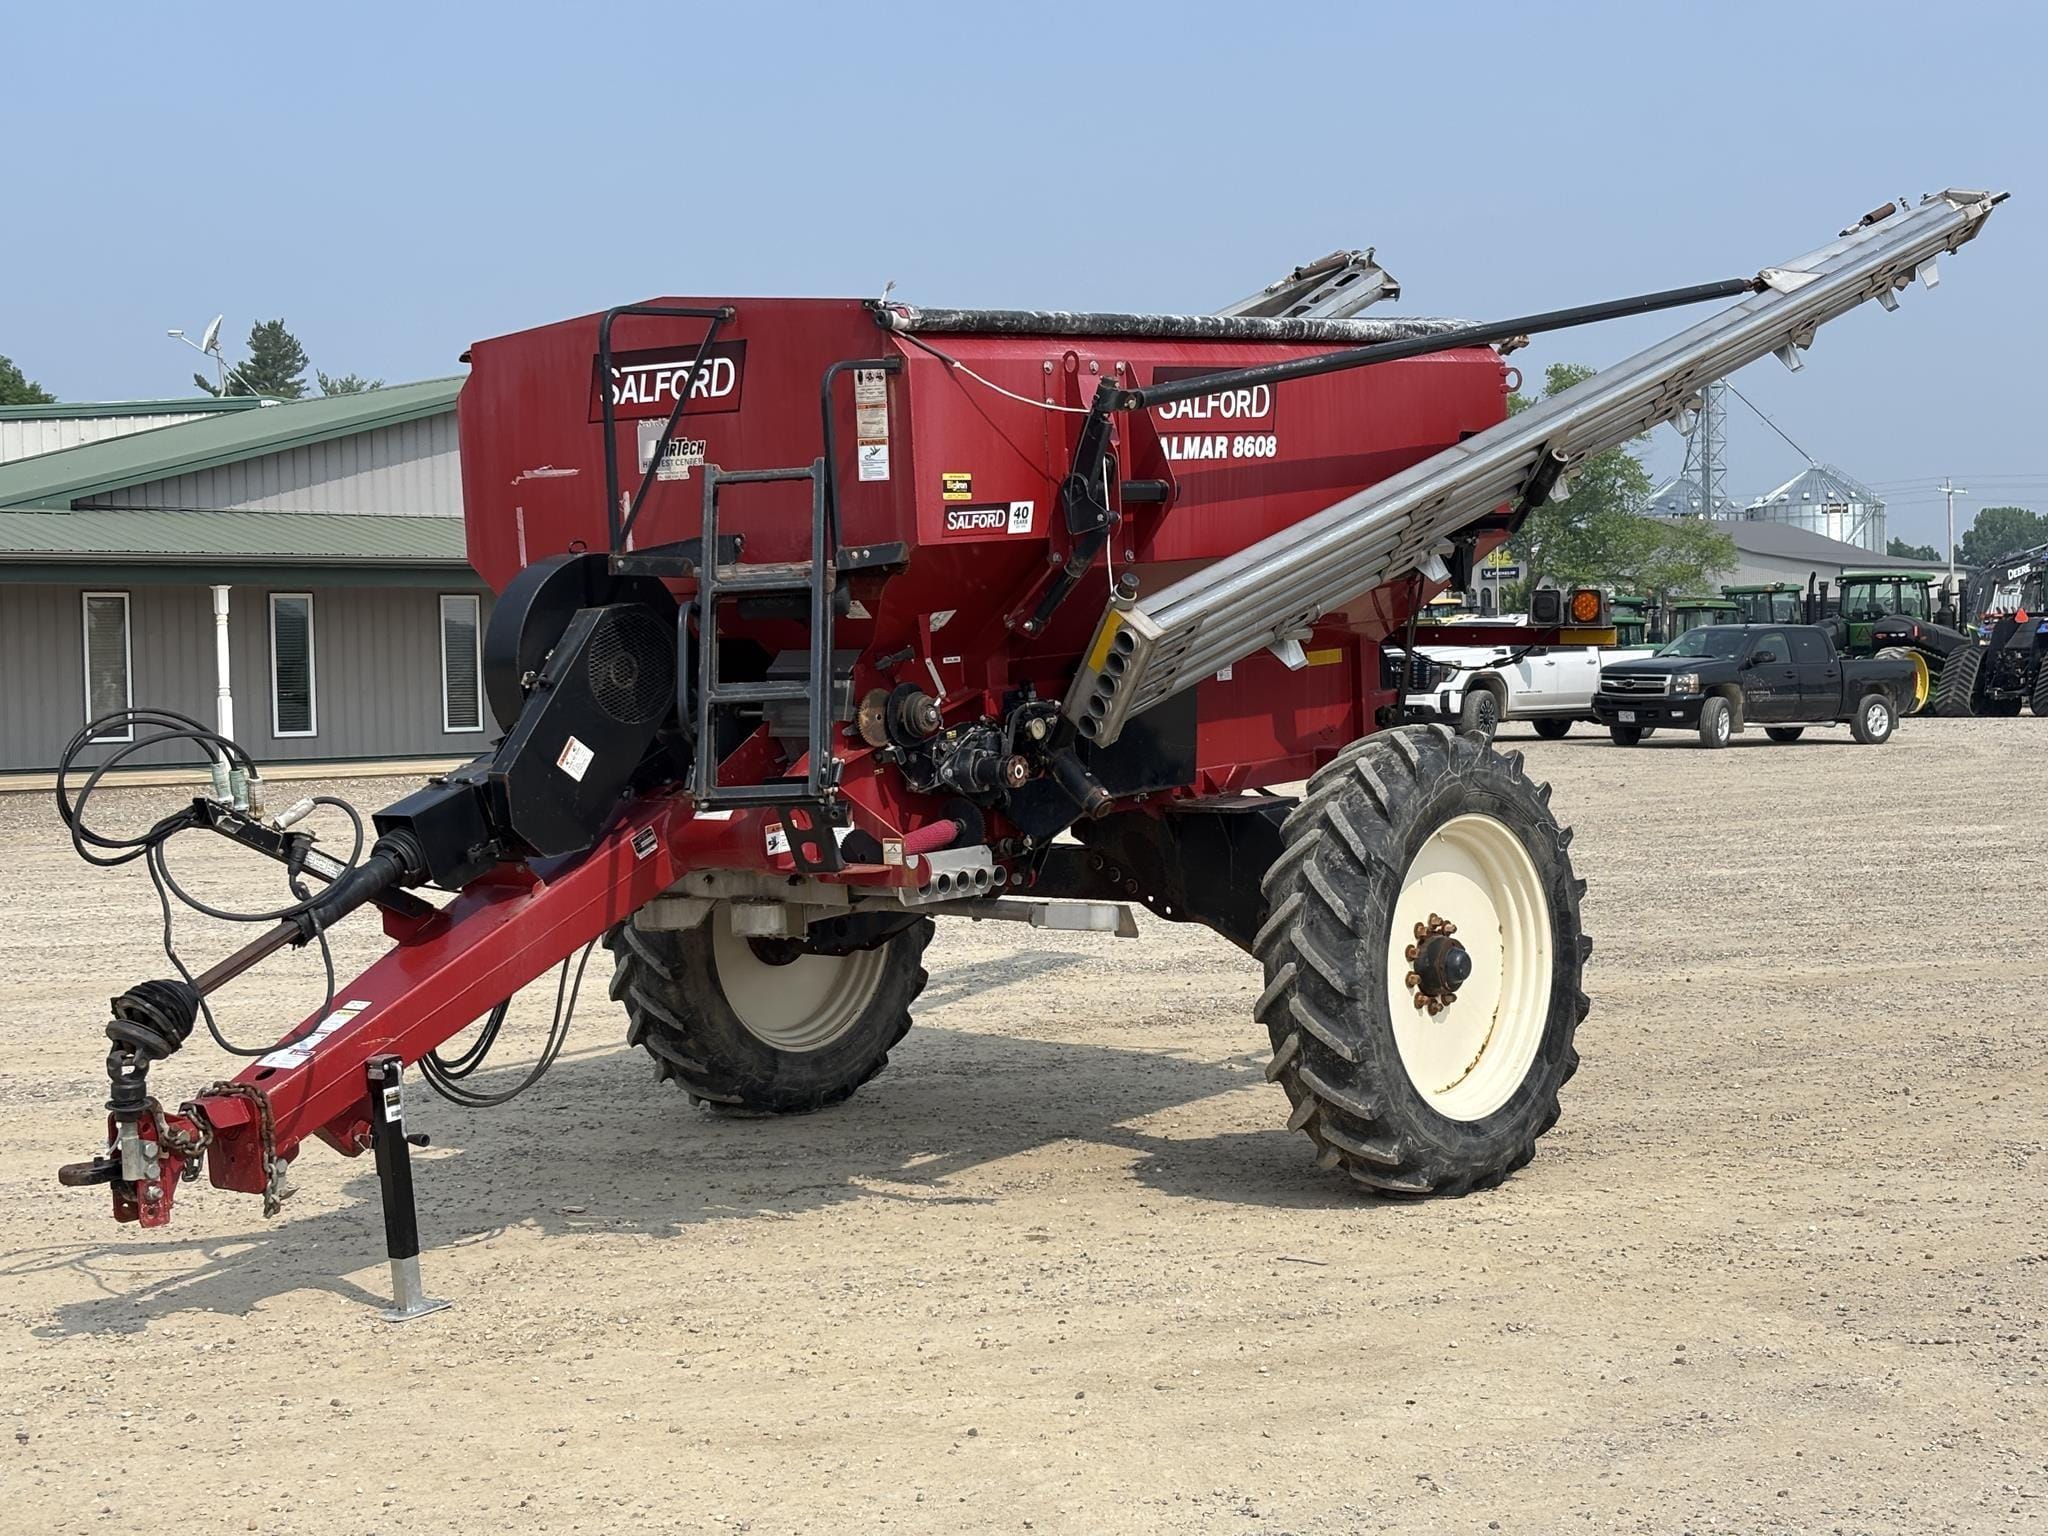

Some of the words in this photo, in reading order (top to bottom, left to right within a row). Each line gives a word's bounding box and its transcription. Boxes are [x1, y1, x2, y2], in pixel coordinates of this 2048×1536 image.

[1160, 435, 1228, 460] ALMAR
[1232, 435, 1277, 458] 8608
[947, 509, 1006, 530] SALFORD
[1013, 506, 1029, 519] 40
[2008, 563, 2031, 580] DEERE
